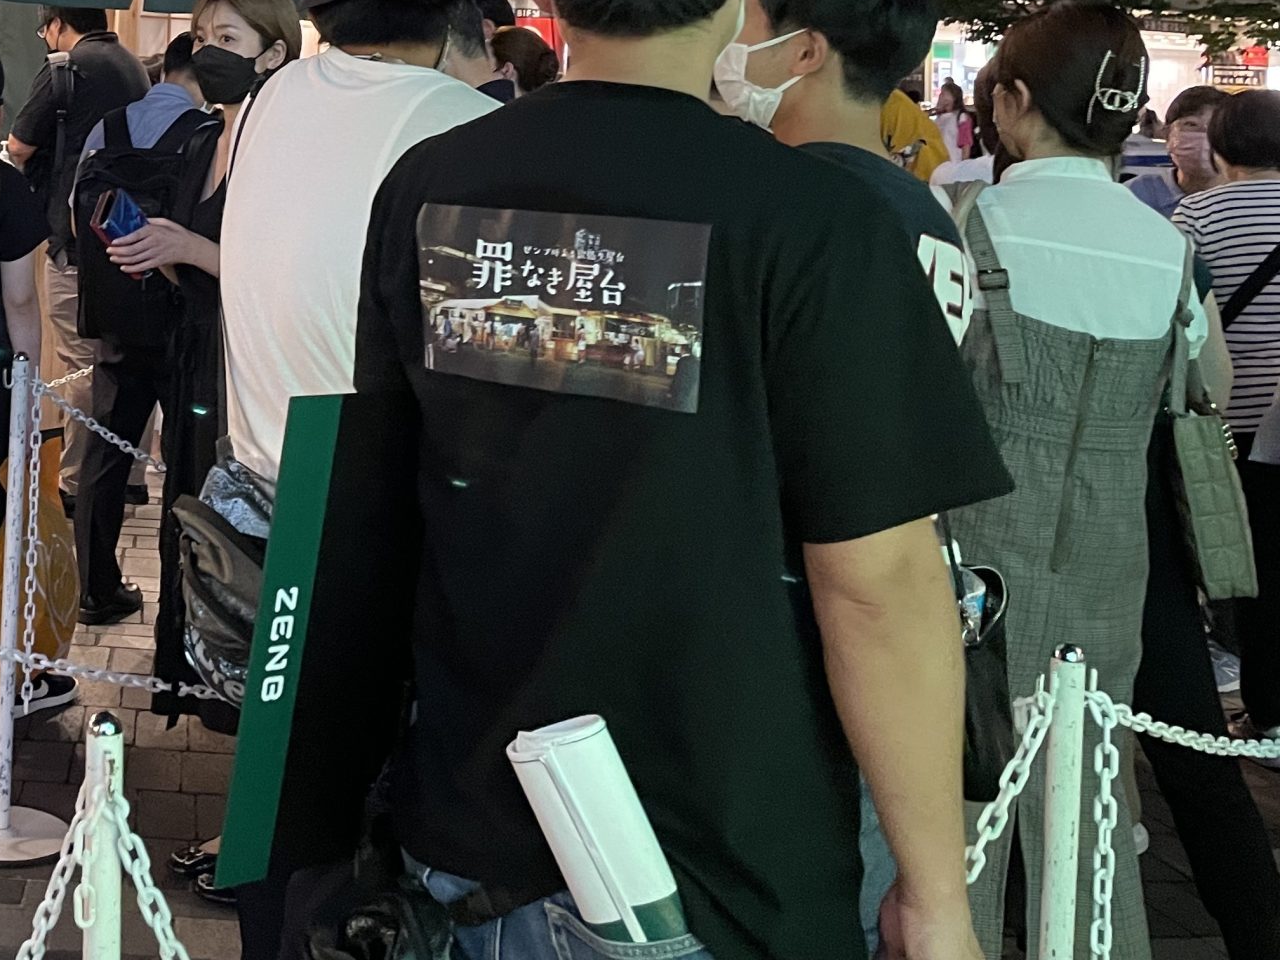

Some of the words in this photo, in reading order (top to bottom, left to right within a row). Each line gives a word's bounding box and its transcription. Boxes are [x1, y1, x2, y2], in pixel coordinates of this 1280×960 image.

[472, 239, 626, 306] 罪なき屋台
[260, 586, 299, 703] ZENB
